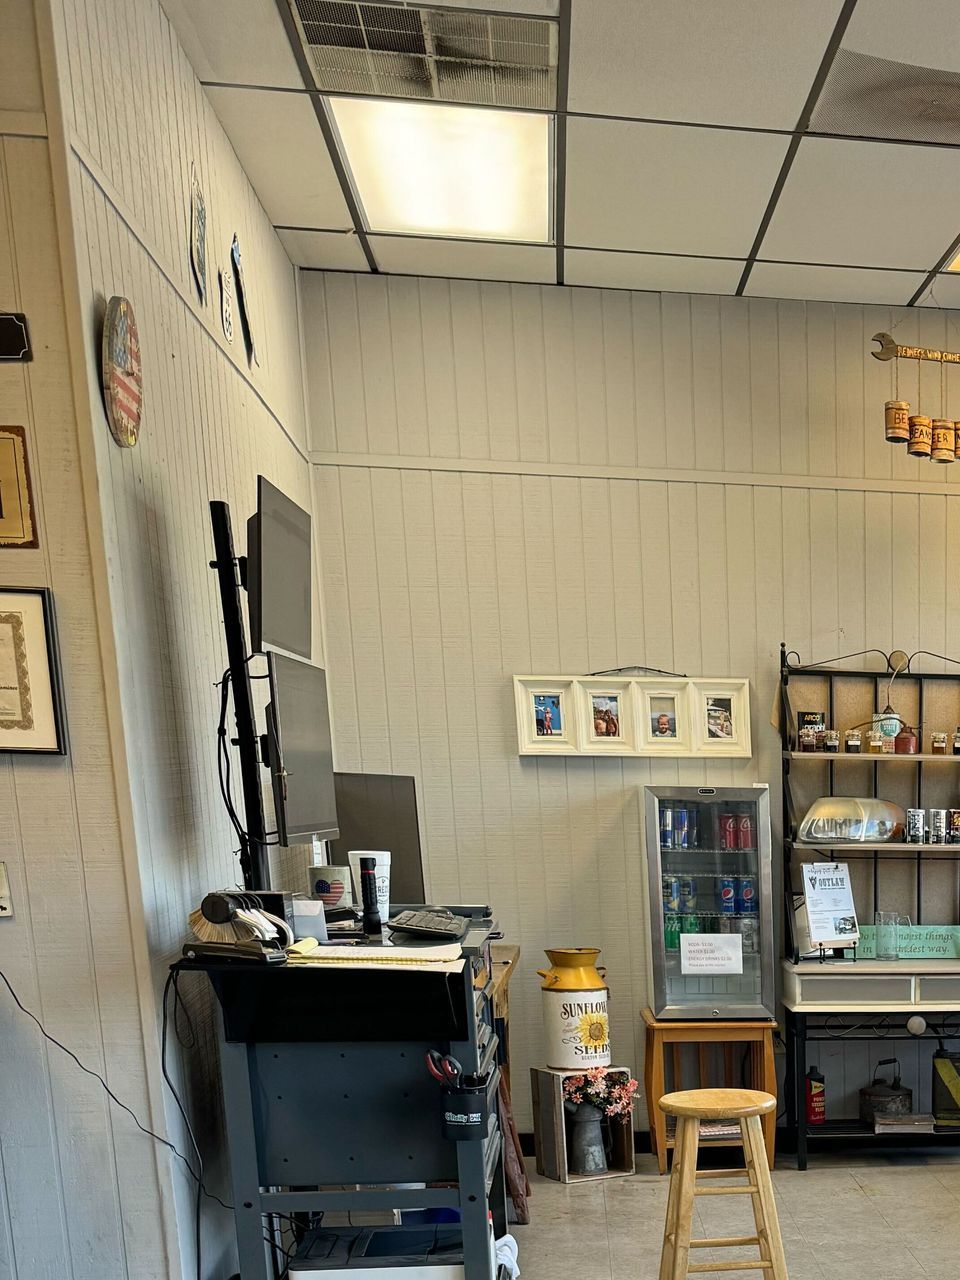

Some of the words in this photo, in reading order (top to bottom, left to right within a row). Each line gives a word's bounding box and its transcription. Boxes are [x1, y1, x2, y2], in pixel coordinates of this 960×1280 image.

[804, 714, 820, 722] ARCO
[818, 877, 846, 888] OUTLAW
[925, 929, 953, 943] things
[863, 945, 872, 954] in
[928, 946, 950, 956] way.
[561, 1001, 607, 1020] SUNFLOW
